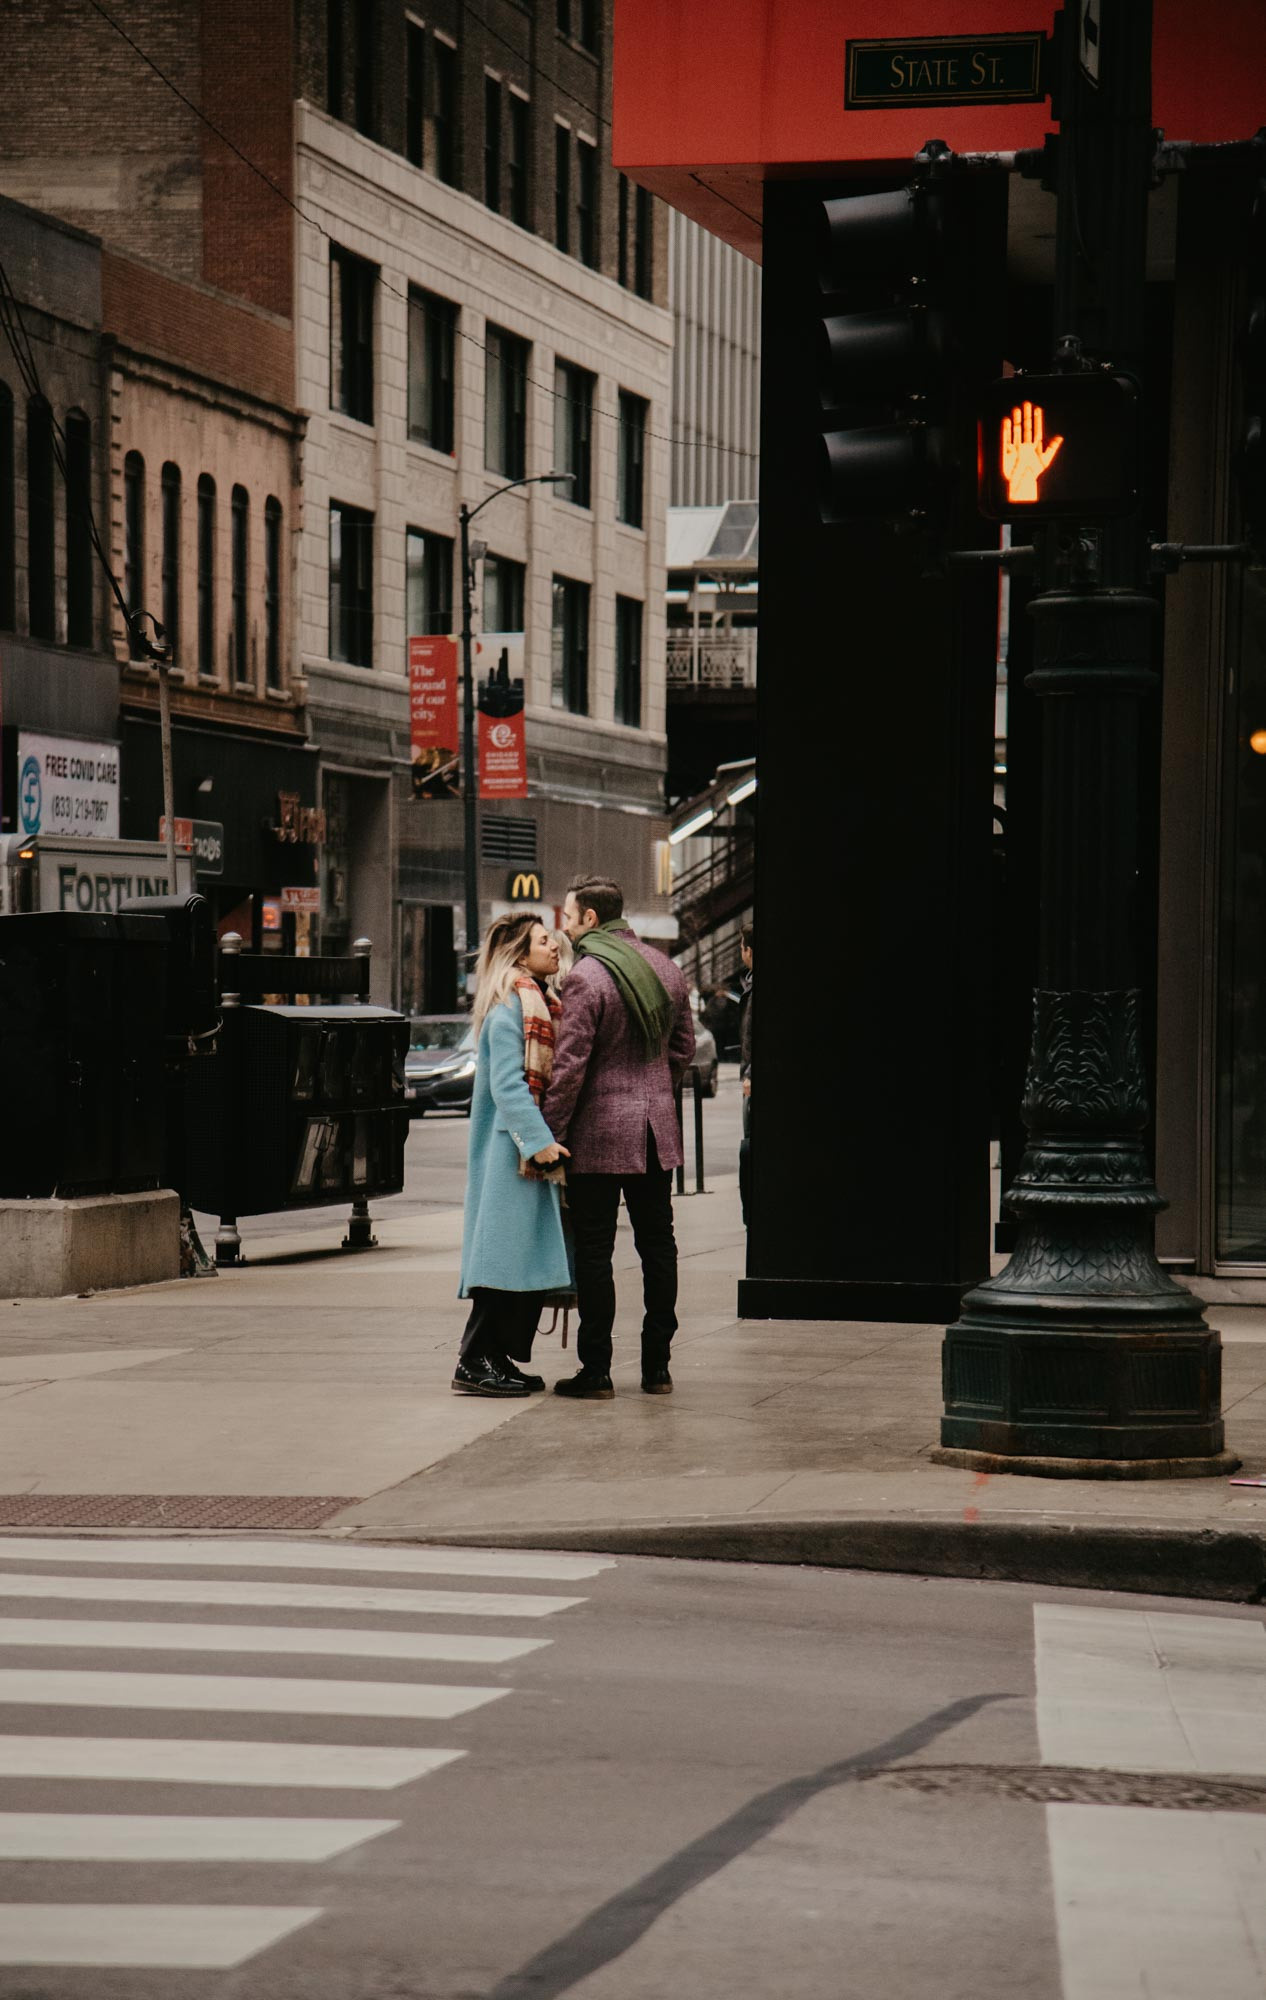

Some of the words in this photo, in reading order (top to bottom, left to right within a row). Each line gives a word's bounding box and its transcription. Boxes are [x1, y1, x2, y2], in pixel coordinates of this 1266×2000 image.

[890, 55, 959, 88] STATE
[970, 51, 1005, 85] ST.
[412, 665, 435, 677] The
[412, 678, 446, 691] sound
[412, 693, 425, 705] of
[426, 695, 447, 705] our
[45, 754, 67, 779] FREE
[70, 757, 95, 782] COVID
[96, 761, 117, 784] CARE
